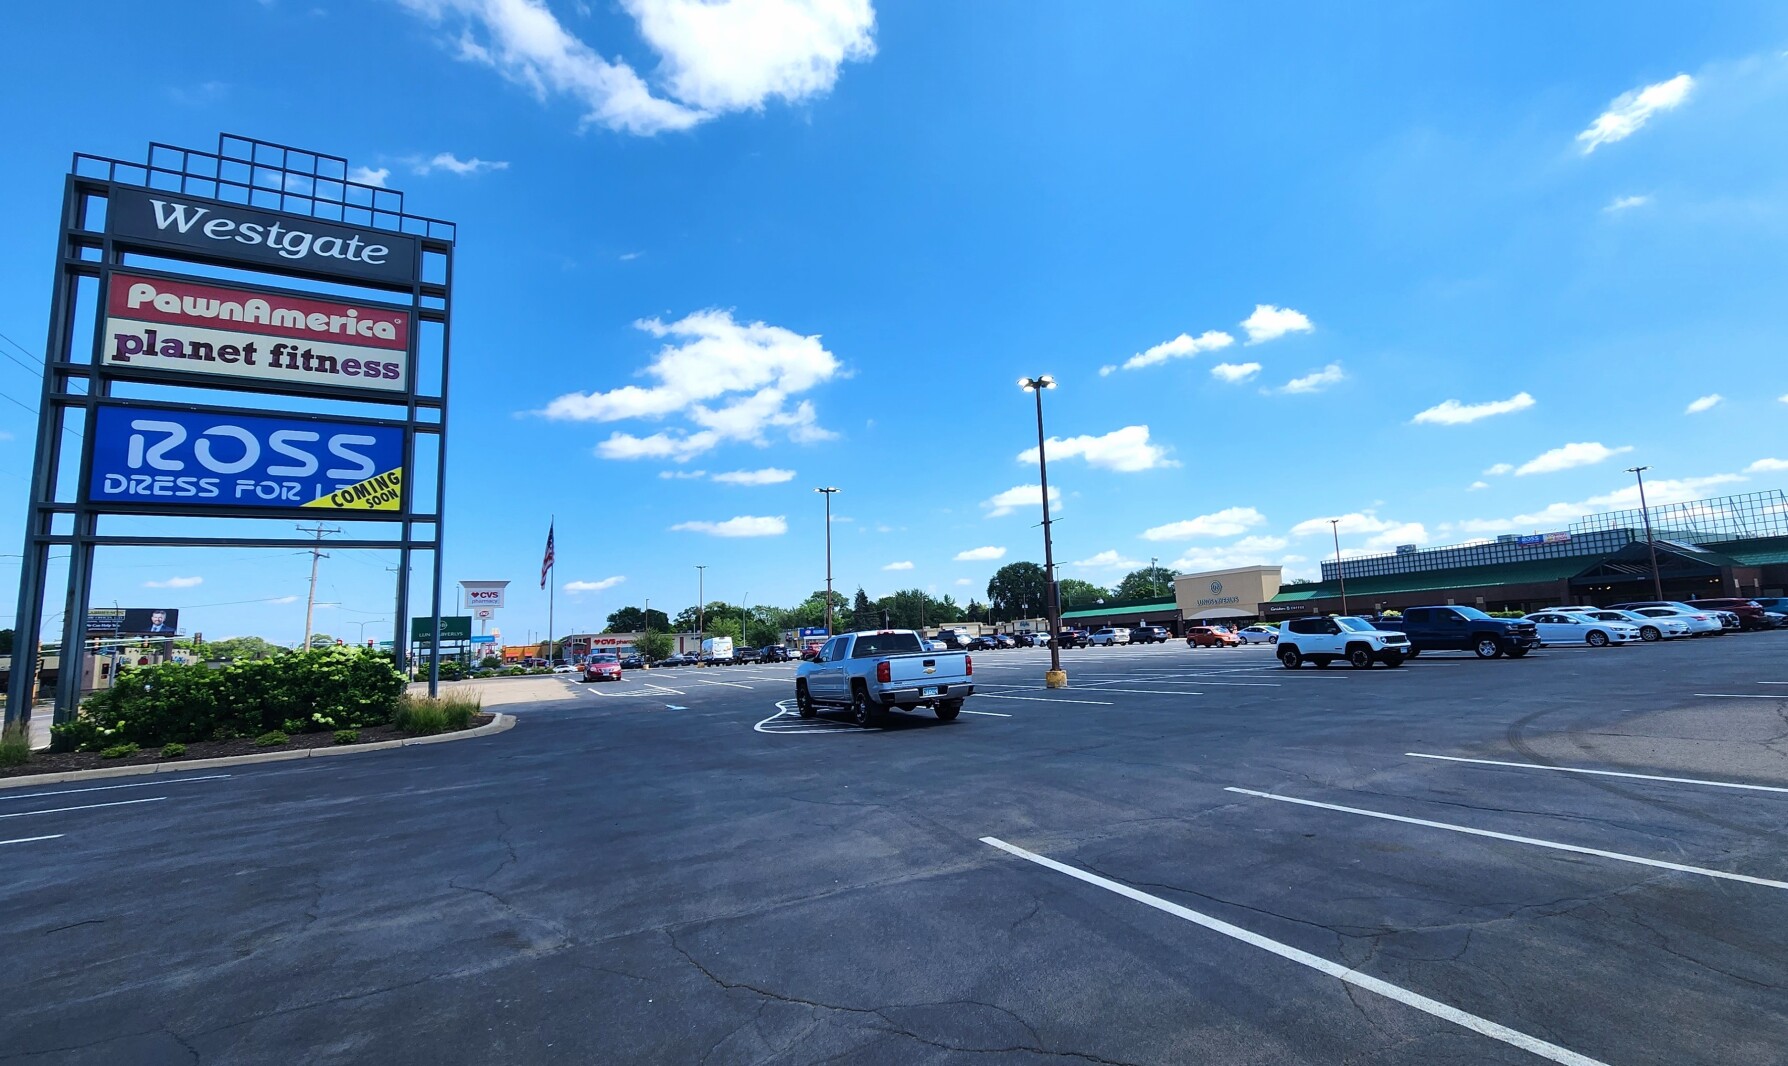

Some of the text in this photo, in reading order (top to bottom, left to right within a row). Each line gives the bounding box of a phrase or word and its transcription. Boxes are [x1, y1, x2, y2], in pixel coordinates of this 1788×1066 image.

[149, 199, 389, 264] Westgate
[111, 329, 400, 380] planet fitness
[127, 419, 377, 480] ROSS
[104, 473, 220, 498] DRESS
[235, 479, 301, 501] FOR
[330, 471, 400, 507] COMING
[365, 488, 399, 509] SOON
[480, 591, 499, 599] CVS
